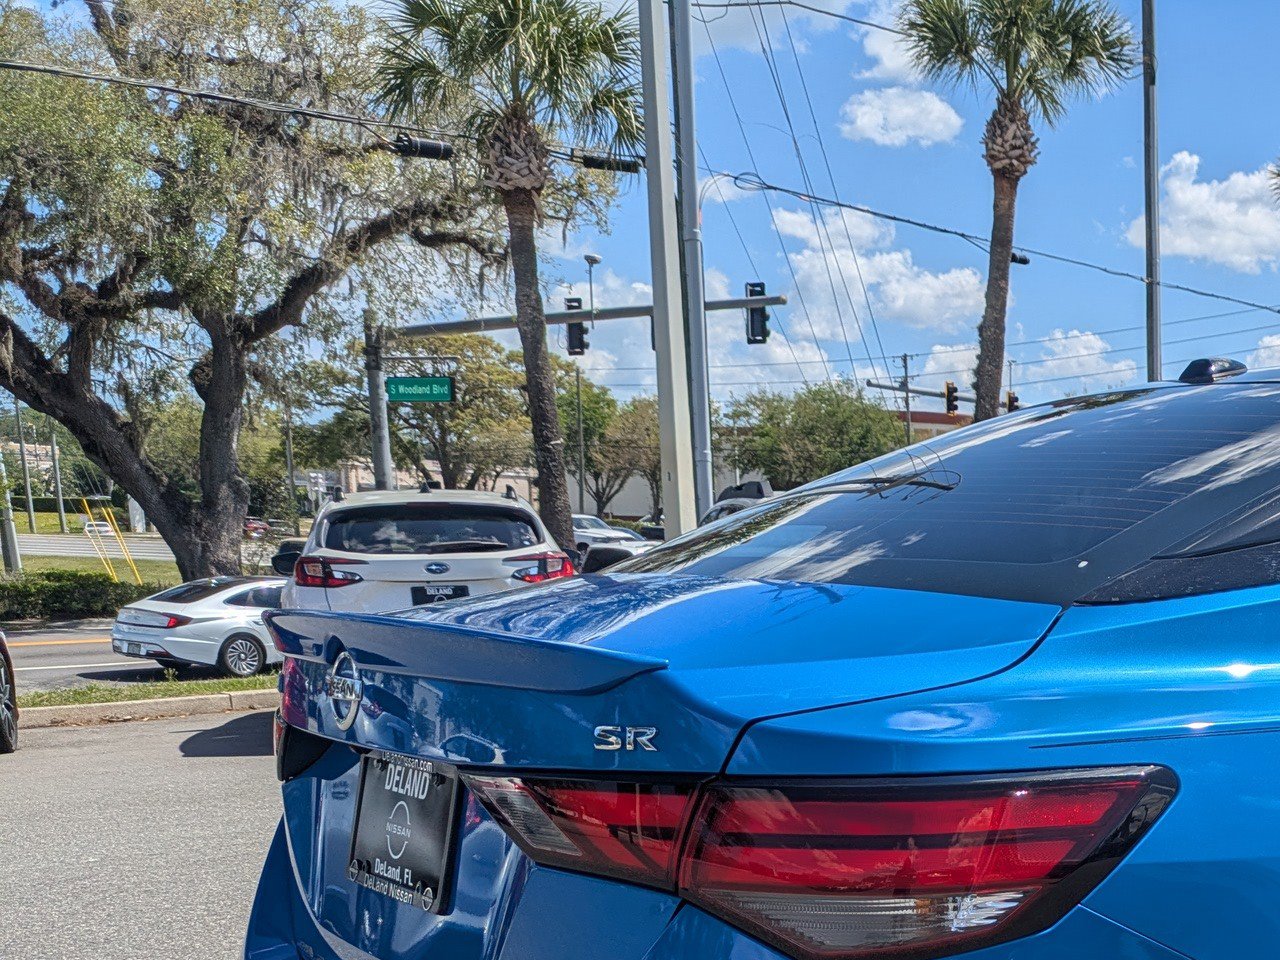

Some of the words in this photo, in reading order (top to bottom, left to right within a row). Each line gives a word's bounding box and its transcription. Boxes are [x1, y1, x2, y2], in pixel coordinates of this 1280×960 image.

[390, 385, 396, 394] S
[398, 384, 431, 395] Woodland
[432, 384, 449, 394] Blvd
[593, 725, 658, 752] SR
[384, 763, 430, 801] DELAND
[386, 822, 412, 838] NISSAN
[374, 858, 403, 884] DeLand,
[404, 868, 414, 886] FL
[363, 873, 389, 895] DeLand
[388, 883, 413, 904] Nissan
